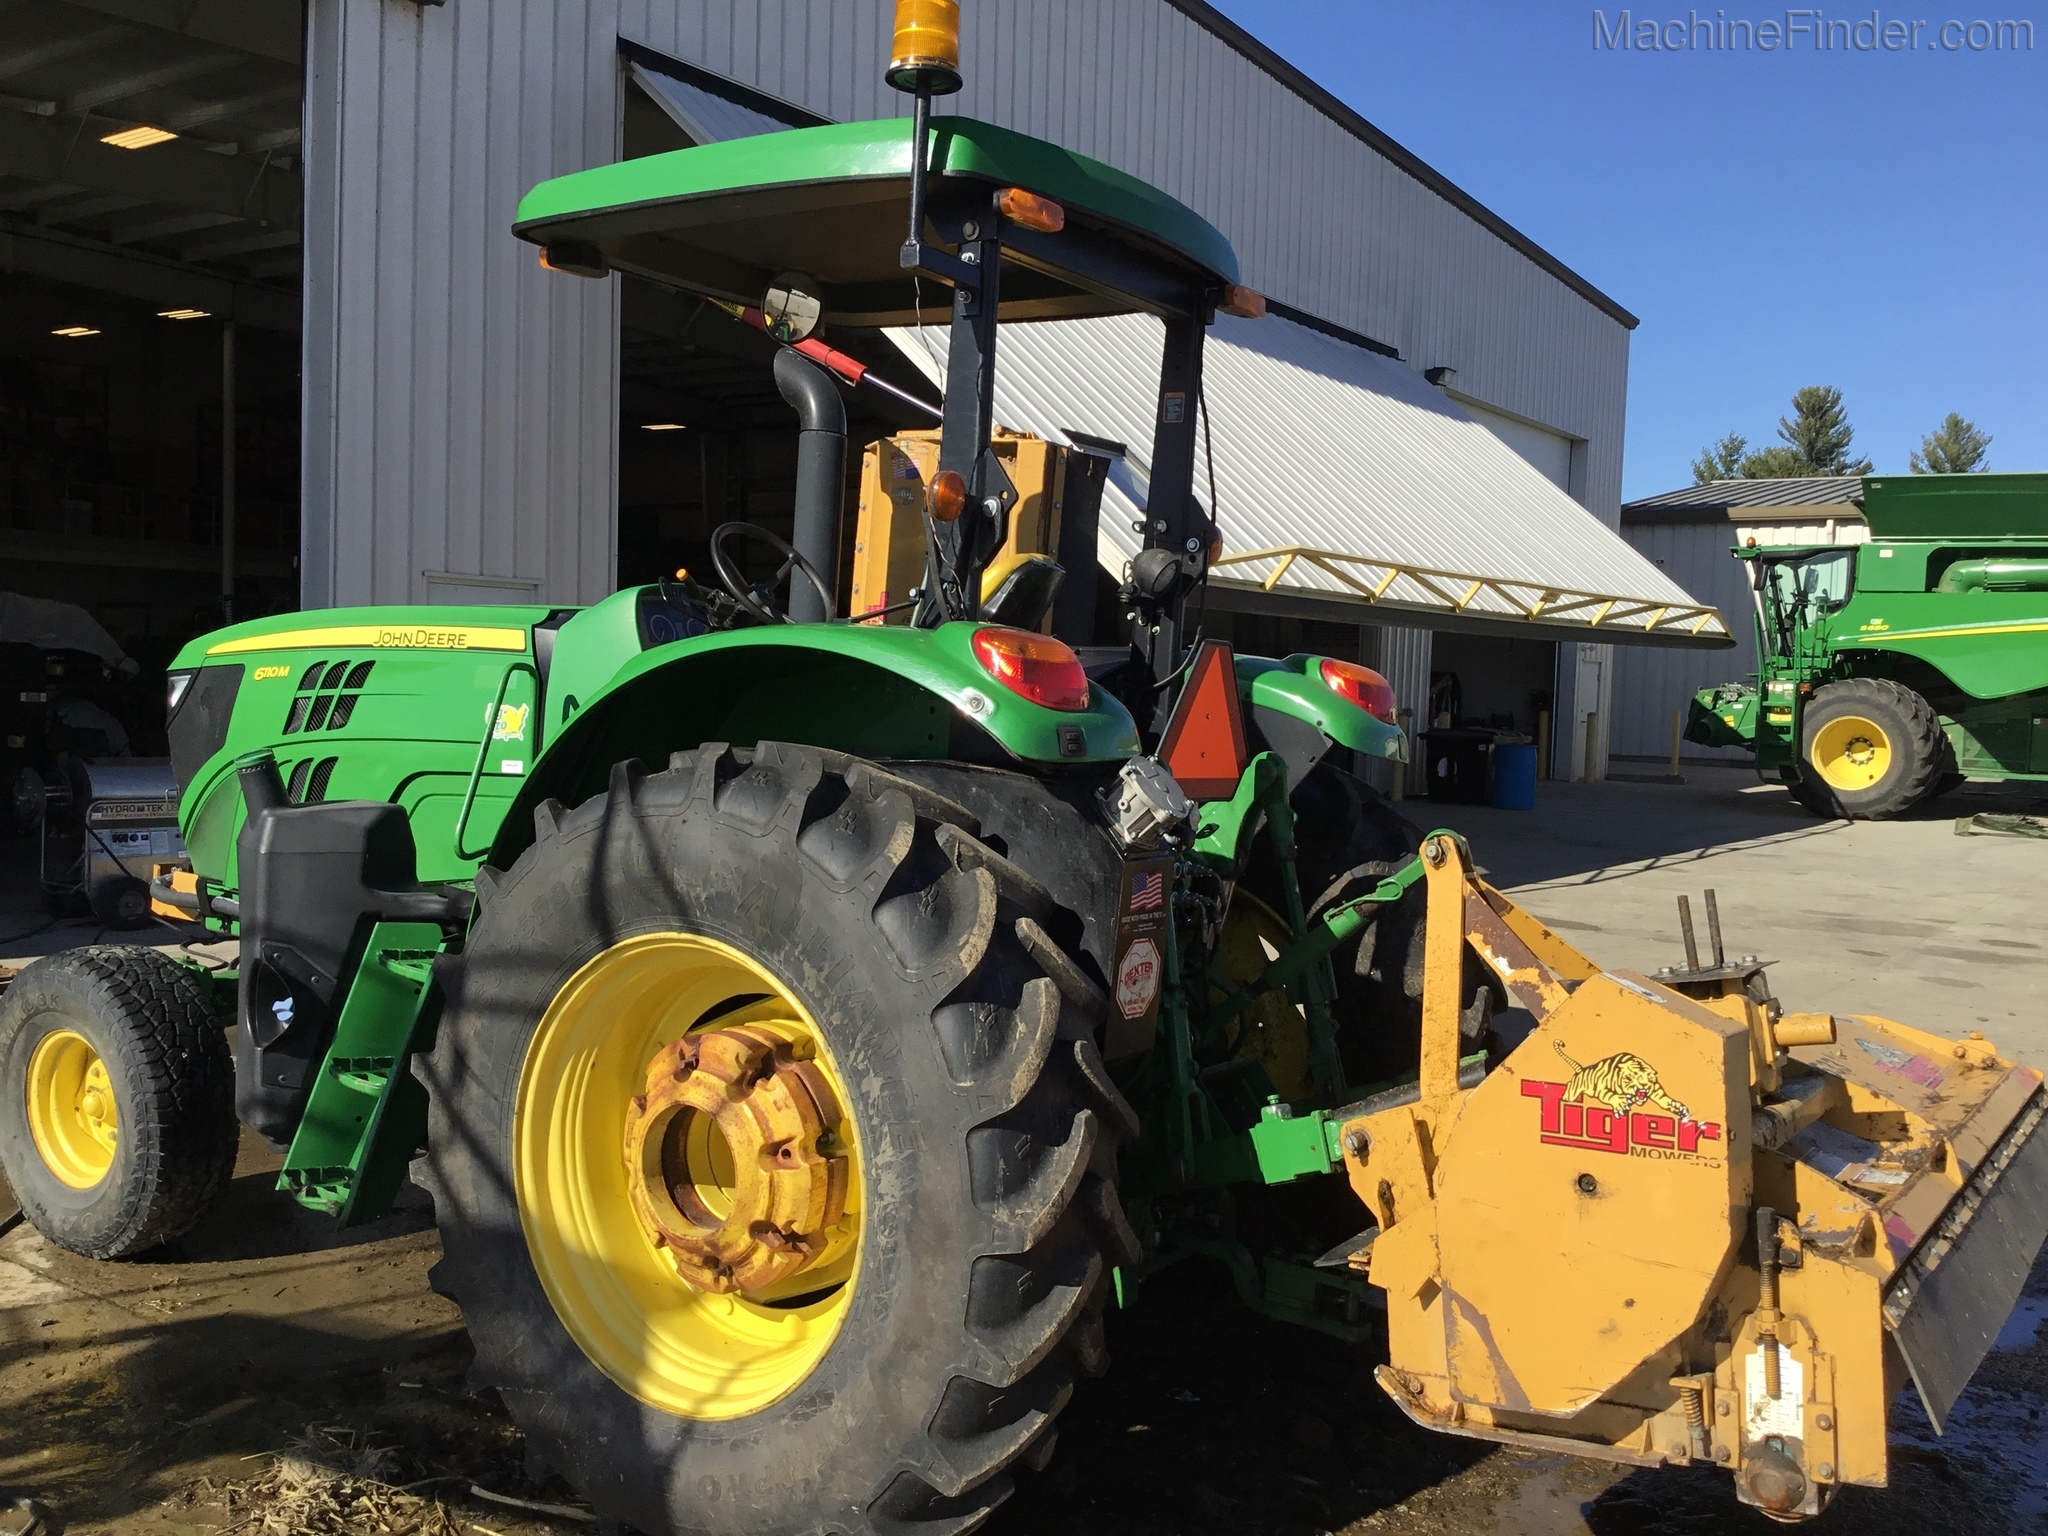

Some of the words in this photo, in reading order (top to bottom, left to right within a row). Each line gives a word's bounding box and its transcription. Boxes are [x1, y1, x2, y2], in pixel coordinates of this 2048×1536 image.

[373, 629, 413, 645] JOHN
[415, 630, 467, 646] DEERE
[254, 665, 290, 681] 6110M
[101, 804, 135, 813] HYDRO
[146, 804, 164, 812] TEK
[166, 803, 178, 812] US
[1124, 962, 1154, 984] DEXTER
[1520, 1078, 1721, 1154] Tiger
